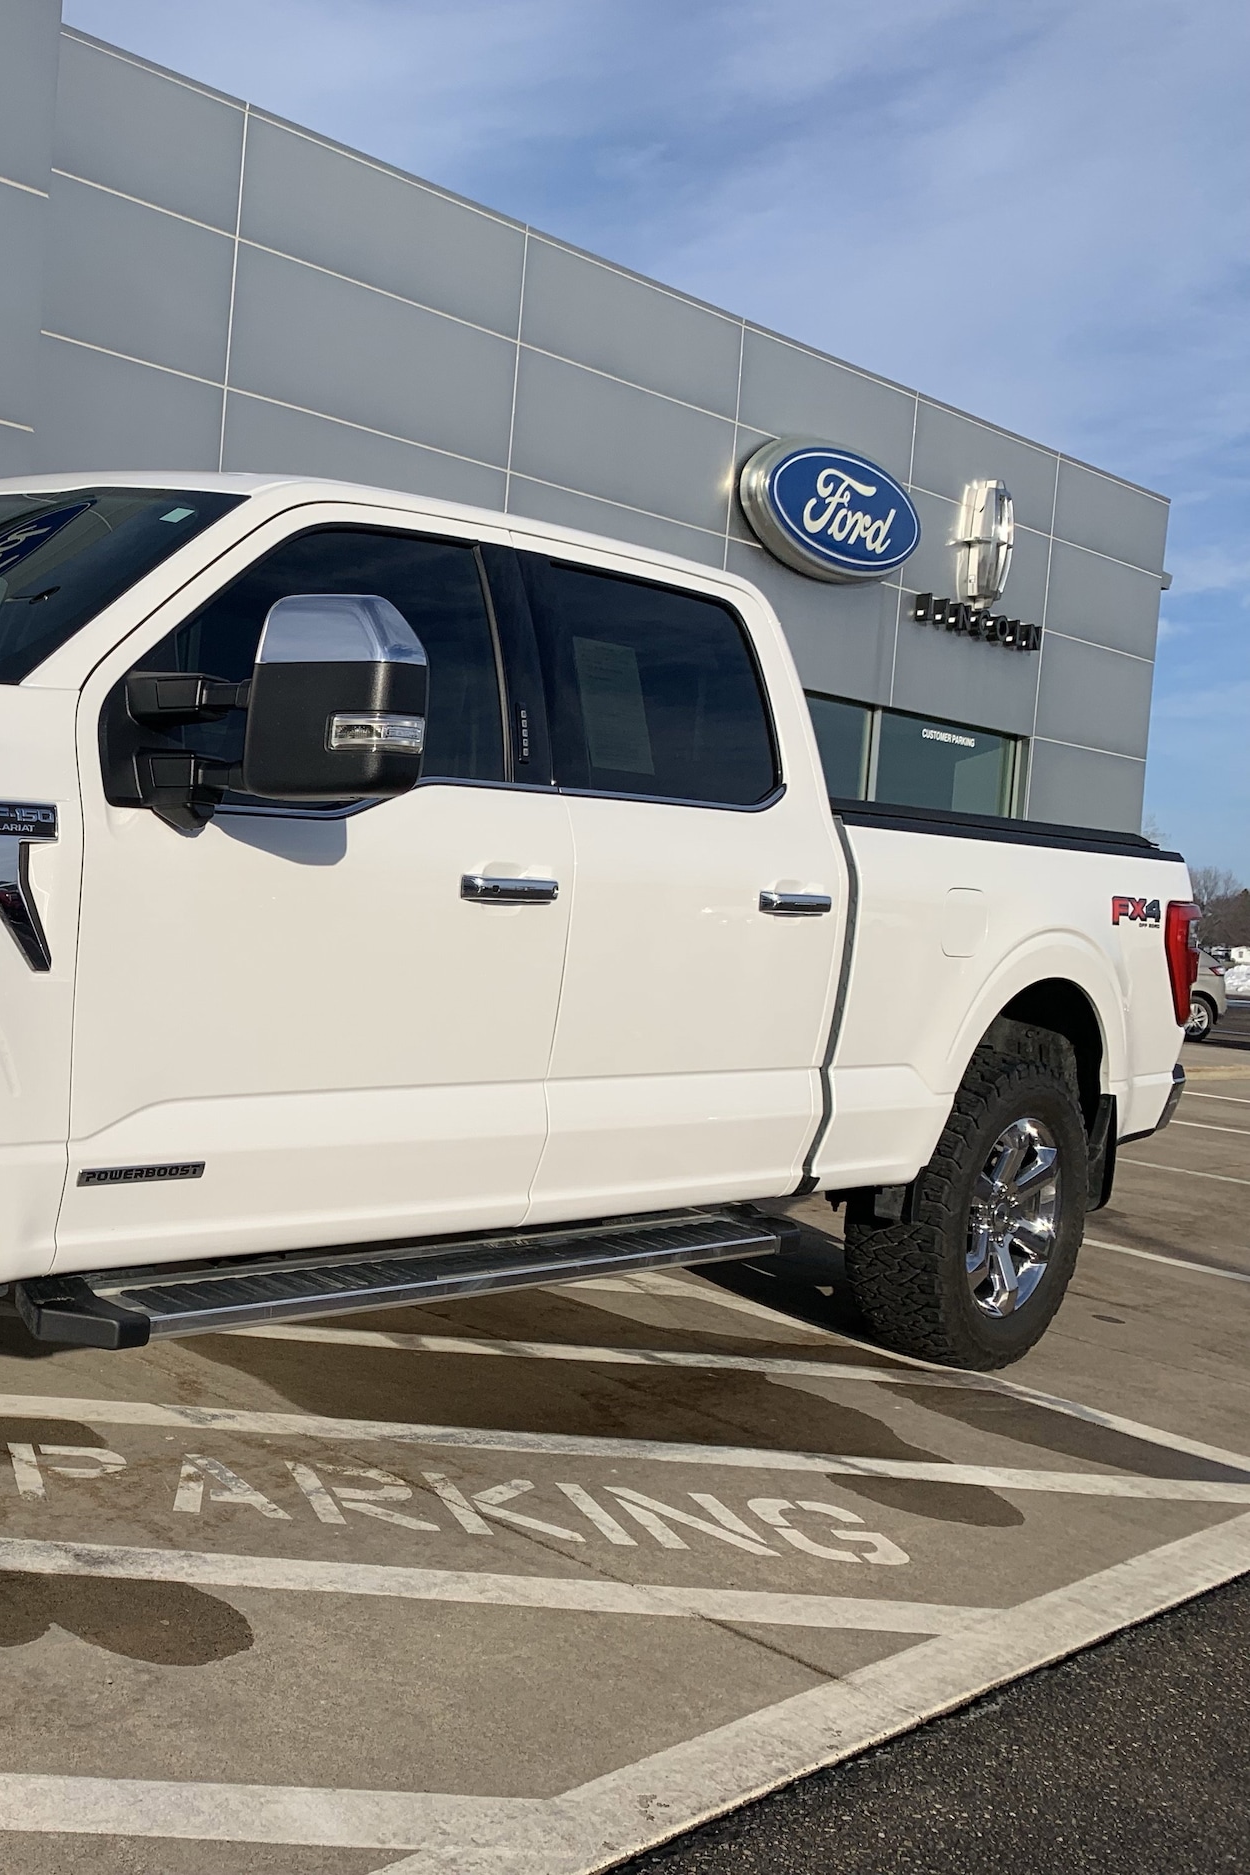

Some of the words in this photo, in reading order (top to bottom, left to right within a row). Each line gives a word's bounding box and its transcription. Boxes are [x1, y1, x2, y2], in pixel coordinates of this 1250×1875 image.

[803, 467, 897, 554] Ford
[921, 728, 952, 743] CUSTOMER
[951, 734, 976, 748] PARKING
[1111, 896, 1161, 926] FX4
[84, 1164, 201, 1182] POWERBOOST
[6, 1442, 911, 1567] PARKING
